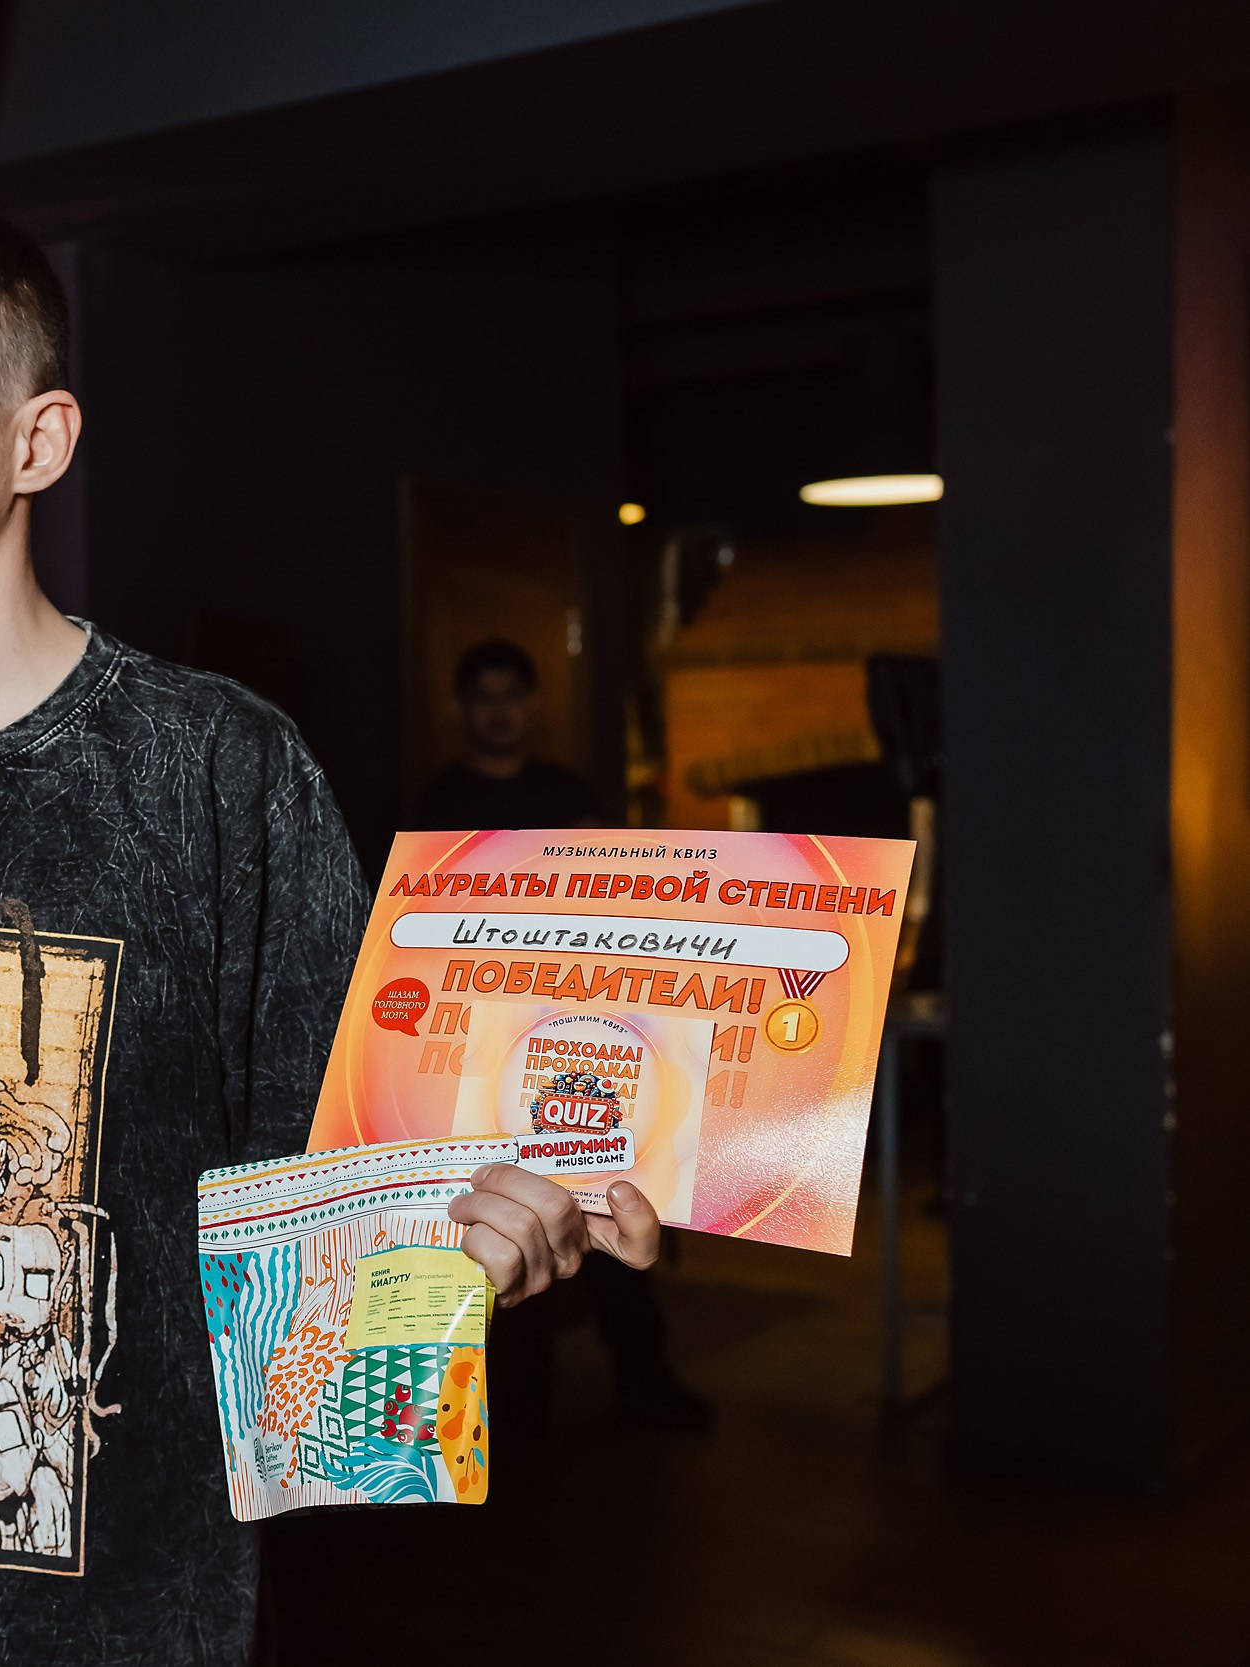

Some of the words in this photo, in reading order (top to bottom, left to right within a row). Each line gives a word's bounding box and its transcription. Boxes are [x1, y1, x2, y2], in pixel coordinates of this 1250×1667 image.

[543, 846, 666, 859] МУЗЫКАЛЬНЫЙ
[673, 848, 718, 860] КВИЗ
[389, 873, 560, 898] ЛАУРЕАТЫ
[565, 870, 710, 903] ПЕРВОЙ
[718, 879, 897, 917] СТЕПЕНИ
[388, 991, 420, 999] ШАЗАМ
[441, 960, 766, 1014] ПОБЕДИТЕЛИ!
[374, 1000, 426, 1010] ГОЛОВНОГО
[381, 1011, 409, 1020] МОЗГА
[548, 1015, 600, 1028] "ПОШУМИМ
[602, 1020, 628, 1034] КВИЗ"
[782, 1012, 801, 1042] 1
[528, 1037, 643, 1062] ПРОХОДКА!
[525, 1055, 641, 1079] ПРОХОДКА!
[544, 1100, 608, 1129] QUIZ
[520, 1136, 627, 1159] #ПОШУМИМ?
[555, 1155, 594, 1167] #MUSIC
[596, 1153, 625, 1164] GAME
[370, 1272, 411, 1289] КИАГУТУ
[371, 1268, 391, 1278] КЕНИЯ
